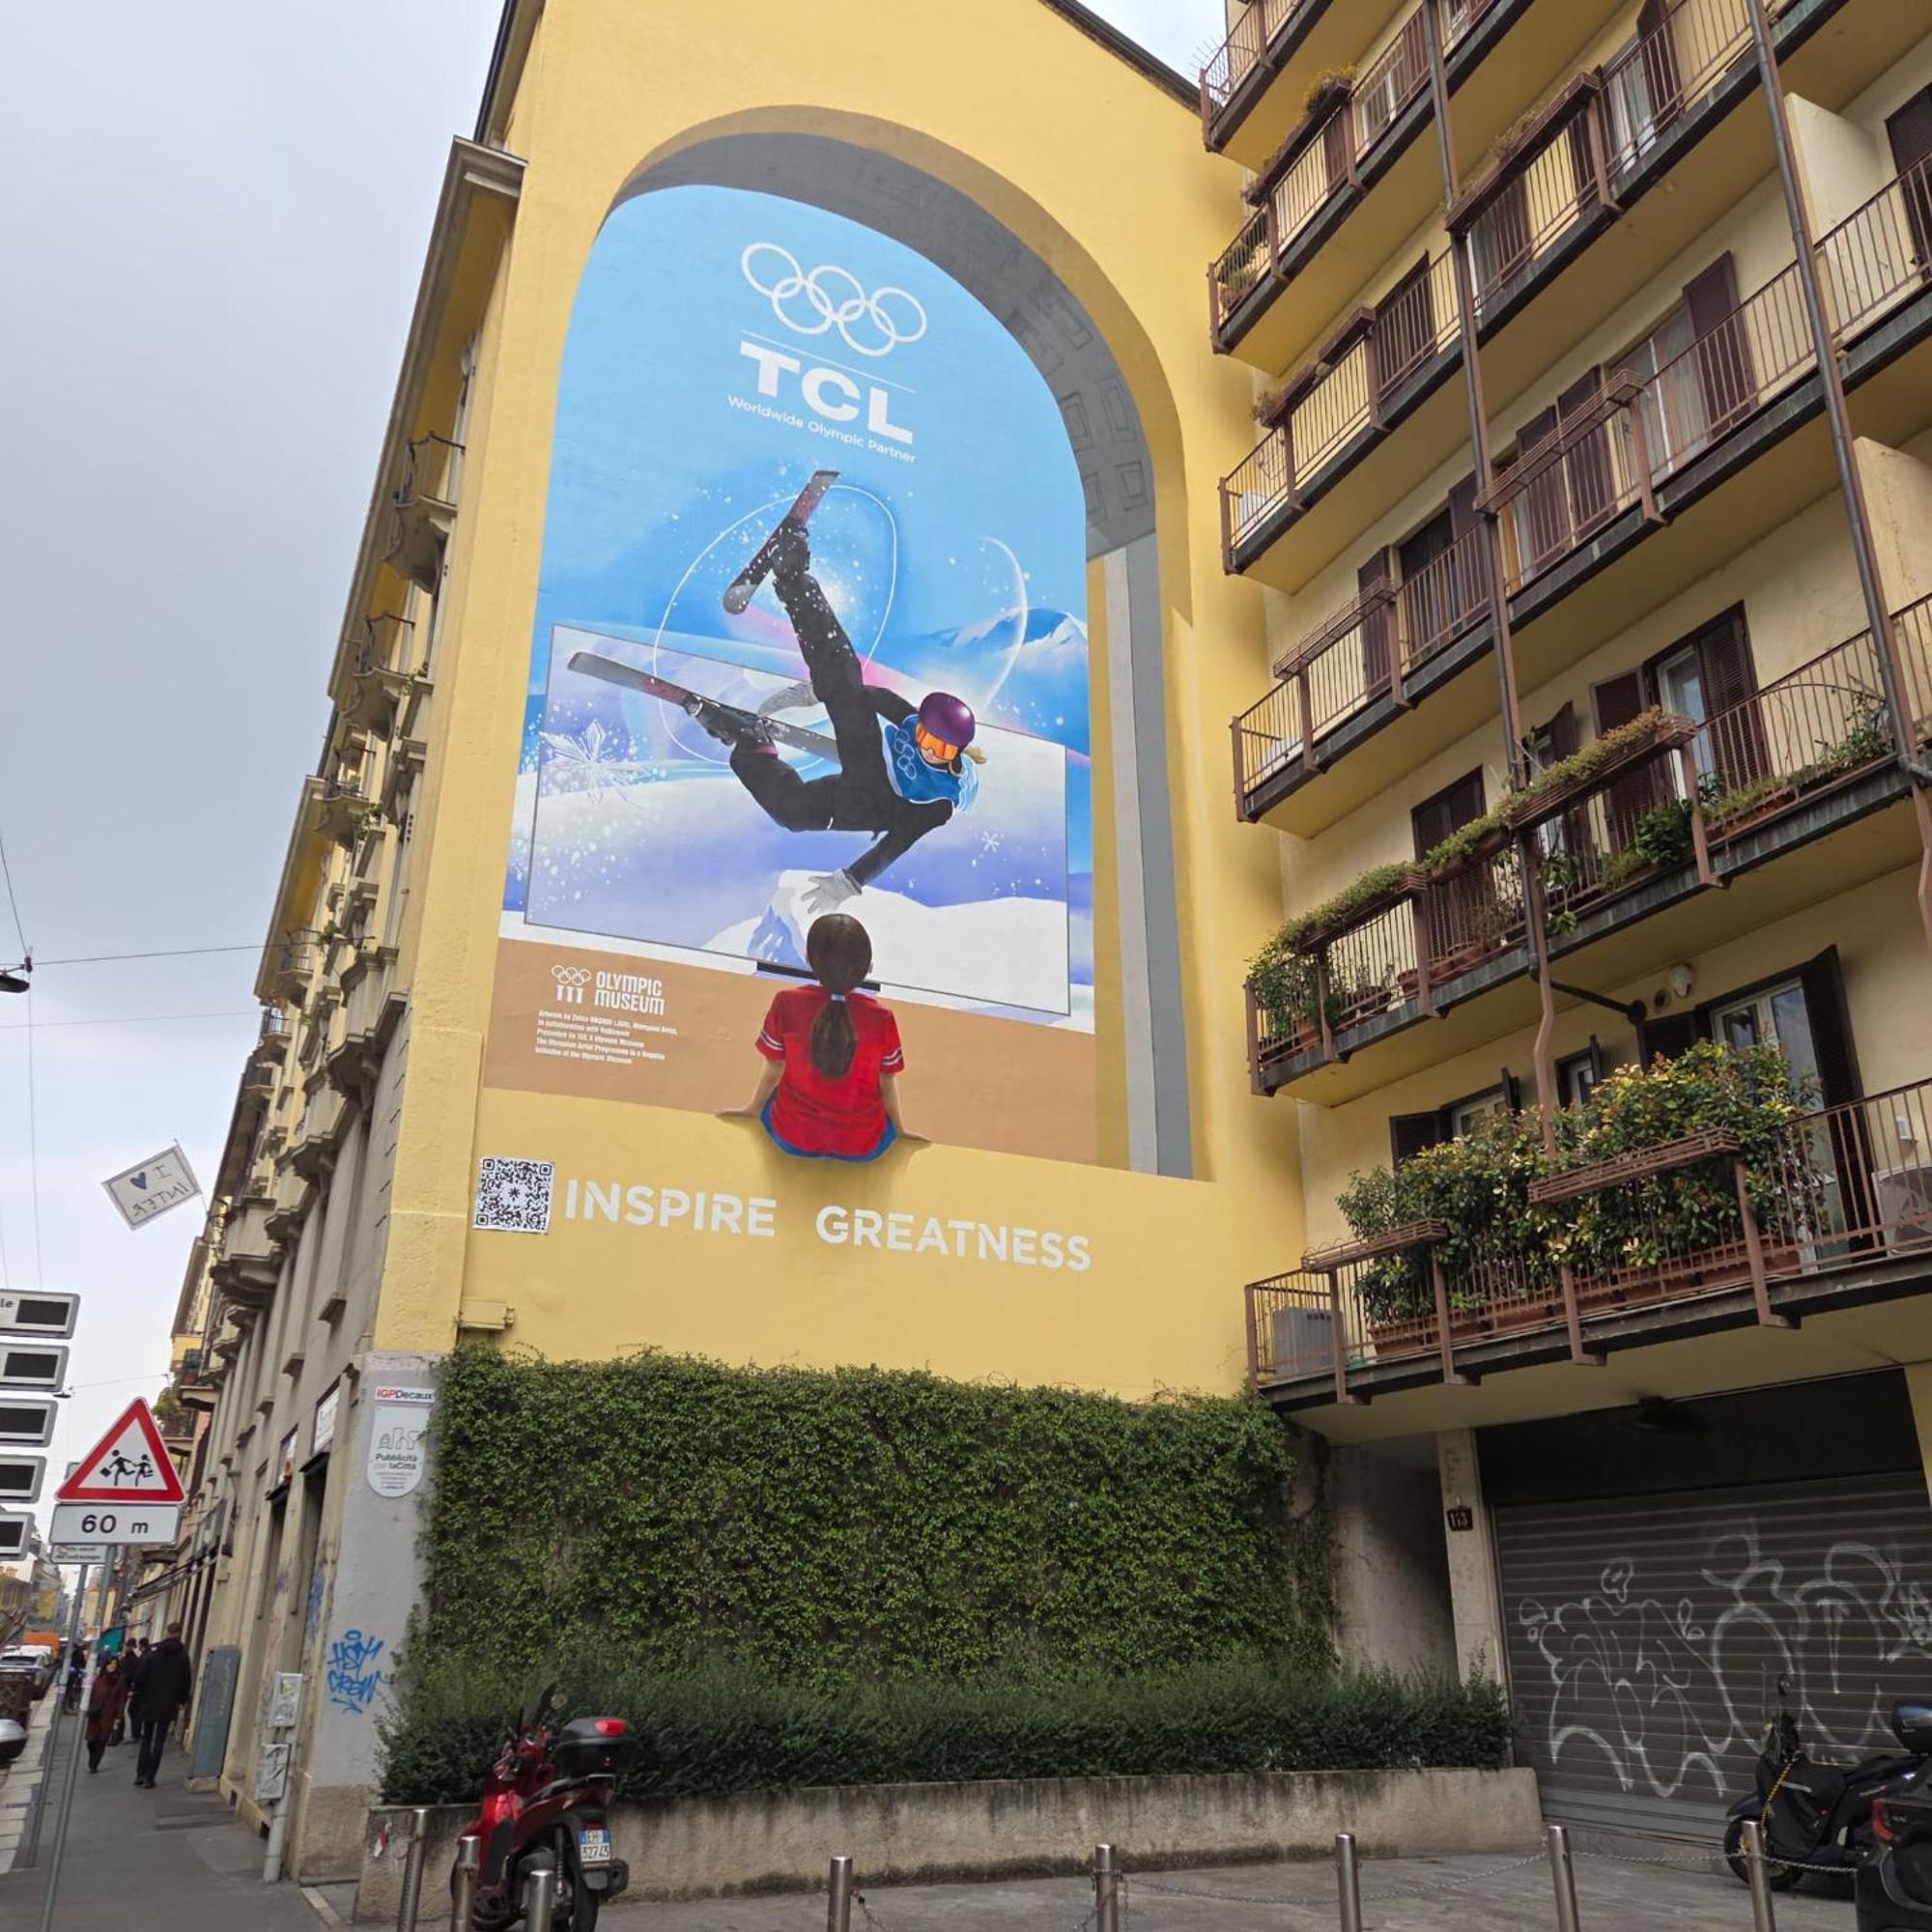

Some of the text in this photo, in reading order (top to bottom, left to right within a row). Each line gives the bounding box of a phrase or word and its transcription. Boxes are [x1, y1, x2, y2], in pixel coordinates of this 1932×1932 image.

[739, 339, 913, 445] TCL
[727, 393, 917, 464] Worldwide Olympic Partner
[594, 989, 665, 1015] MUSEUM
[595, 971, 663, 997] OLYMPIC
[565, 1179, 1092, 1272] INSPIRE GREATNESS
[81, 1514, 149, 1534] 60 m
